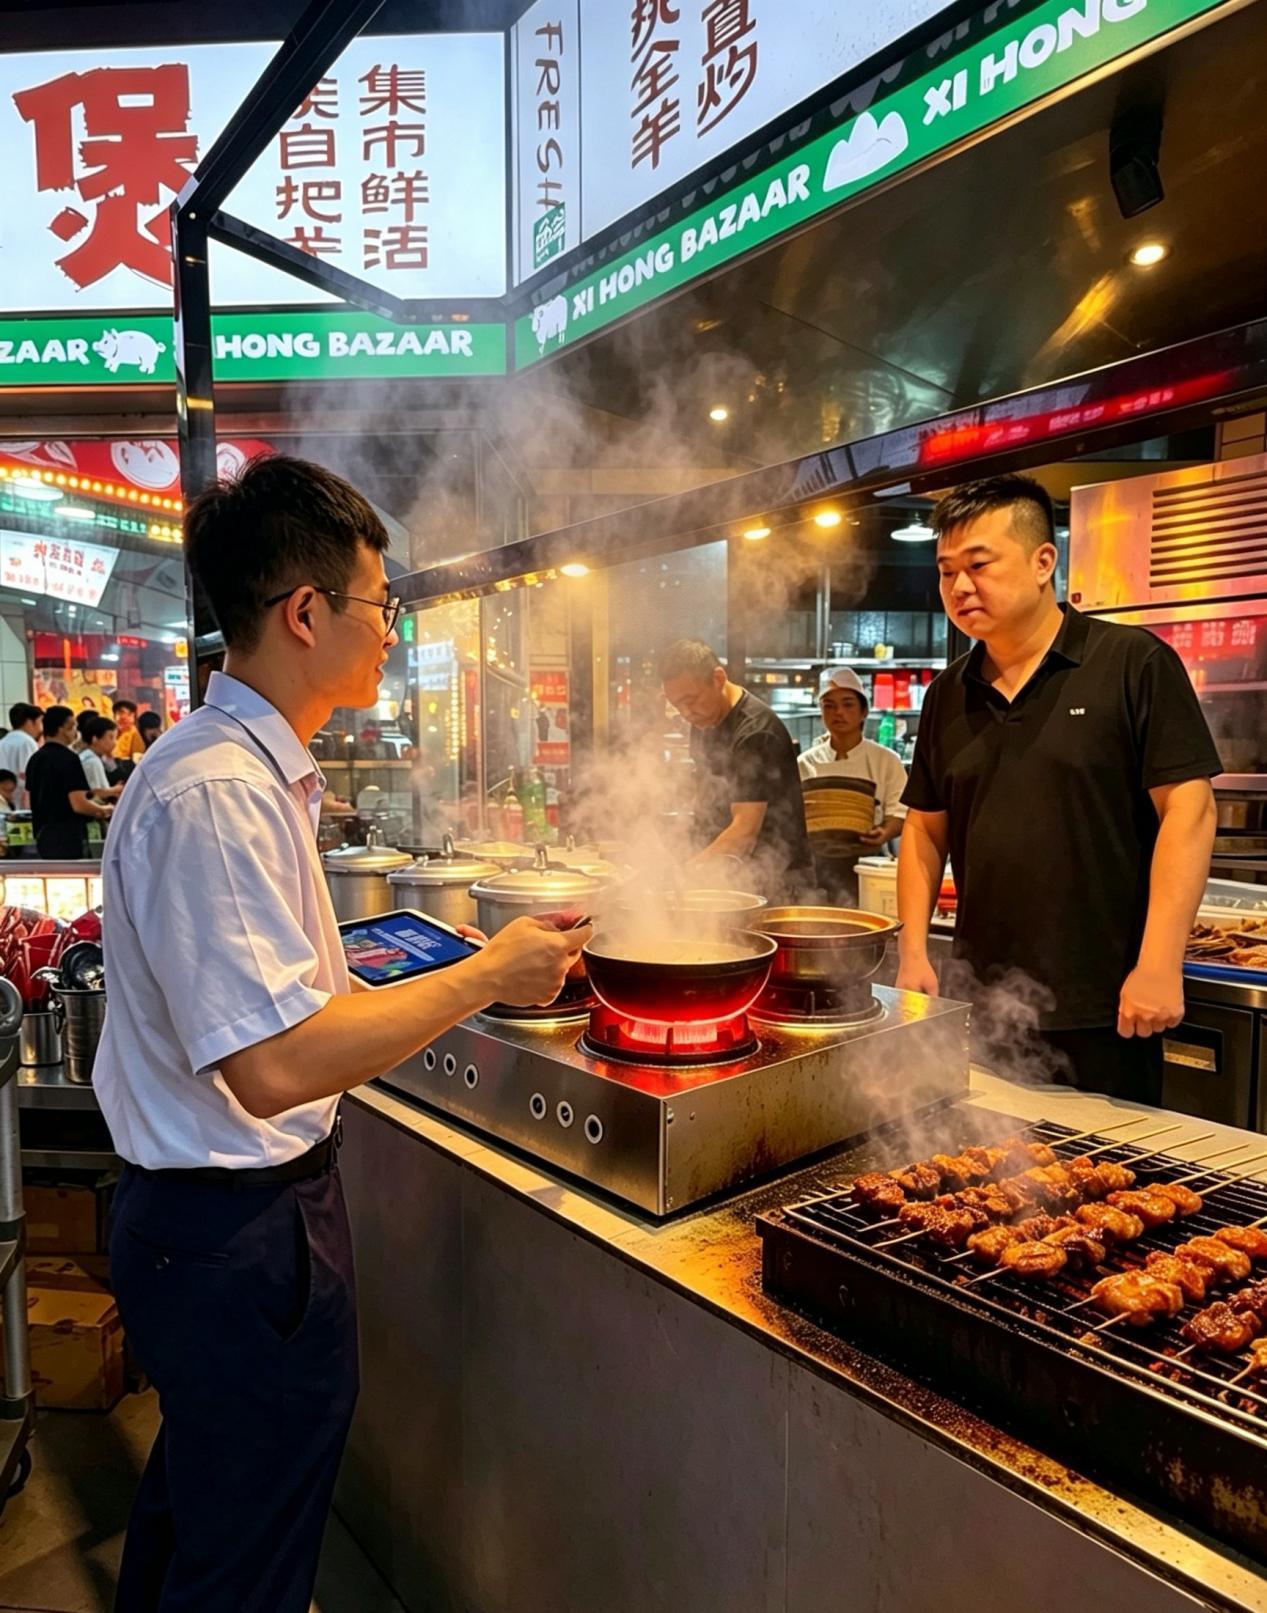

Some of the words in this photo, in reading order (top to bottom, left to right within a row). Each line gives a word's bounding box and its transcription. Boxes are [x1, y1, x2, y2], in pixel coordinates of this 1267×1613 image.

[358, 63, 429, 270] 集市鲜活
[535, 20, 564, 211] FRESH
[922, 69, 968, 126] XI
[12, 63, 199, 291] 煲
[572, 286, 594, 320] XI
[599, 242, 674, 304] HONG
[681, 164, 810, 263] BAZAAR
[0, 338, 90, 365] ZAAR
[215, 332, 320, 359] HONG
[328, 330, 473, 357] BAZAAR
